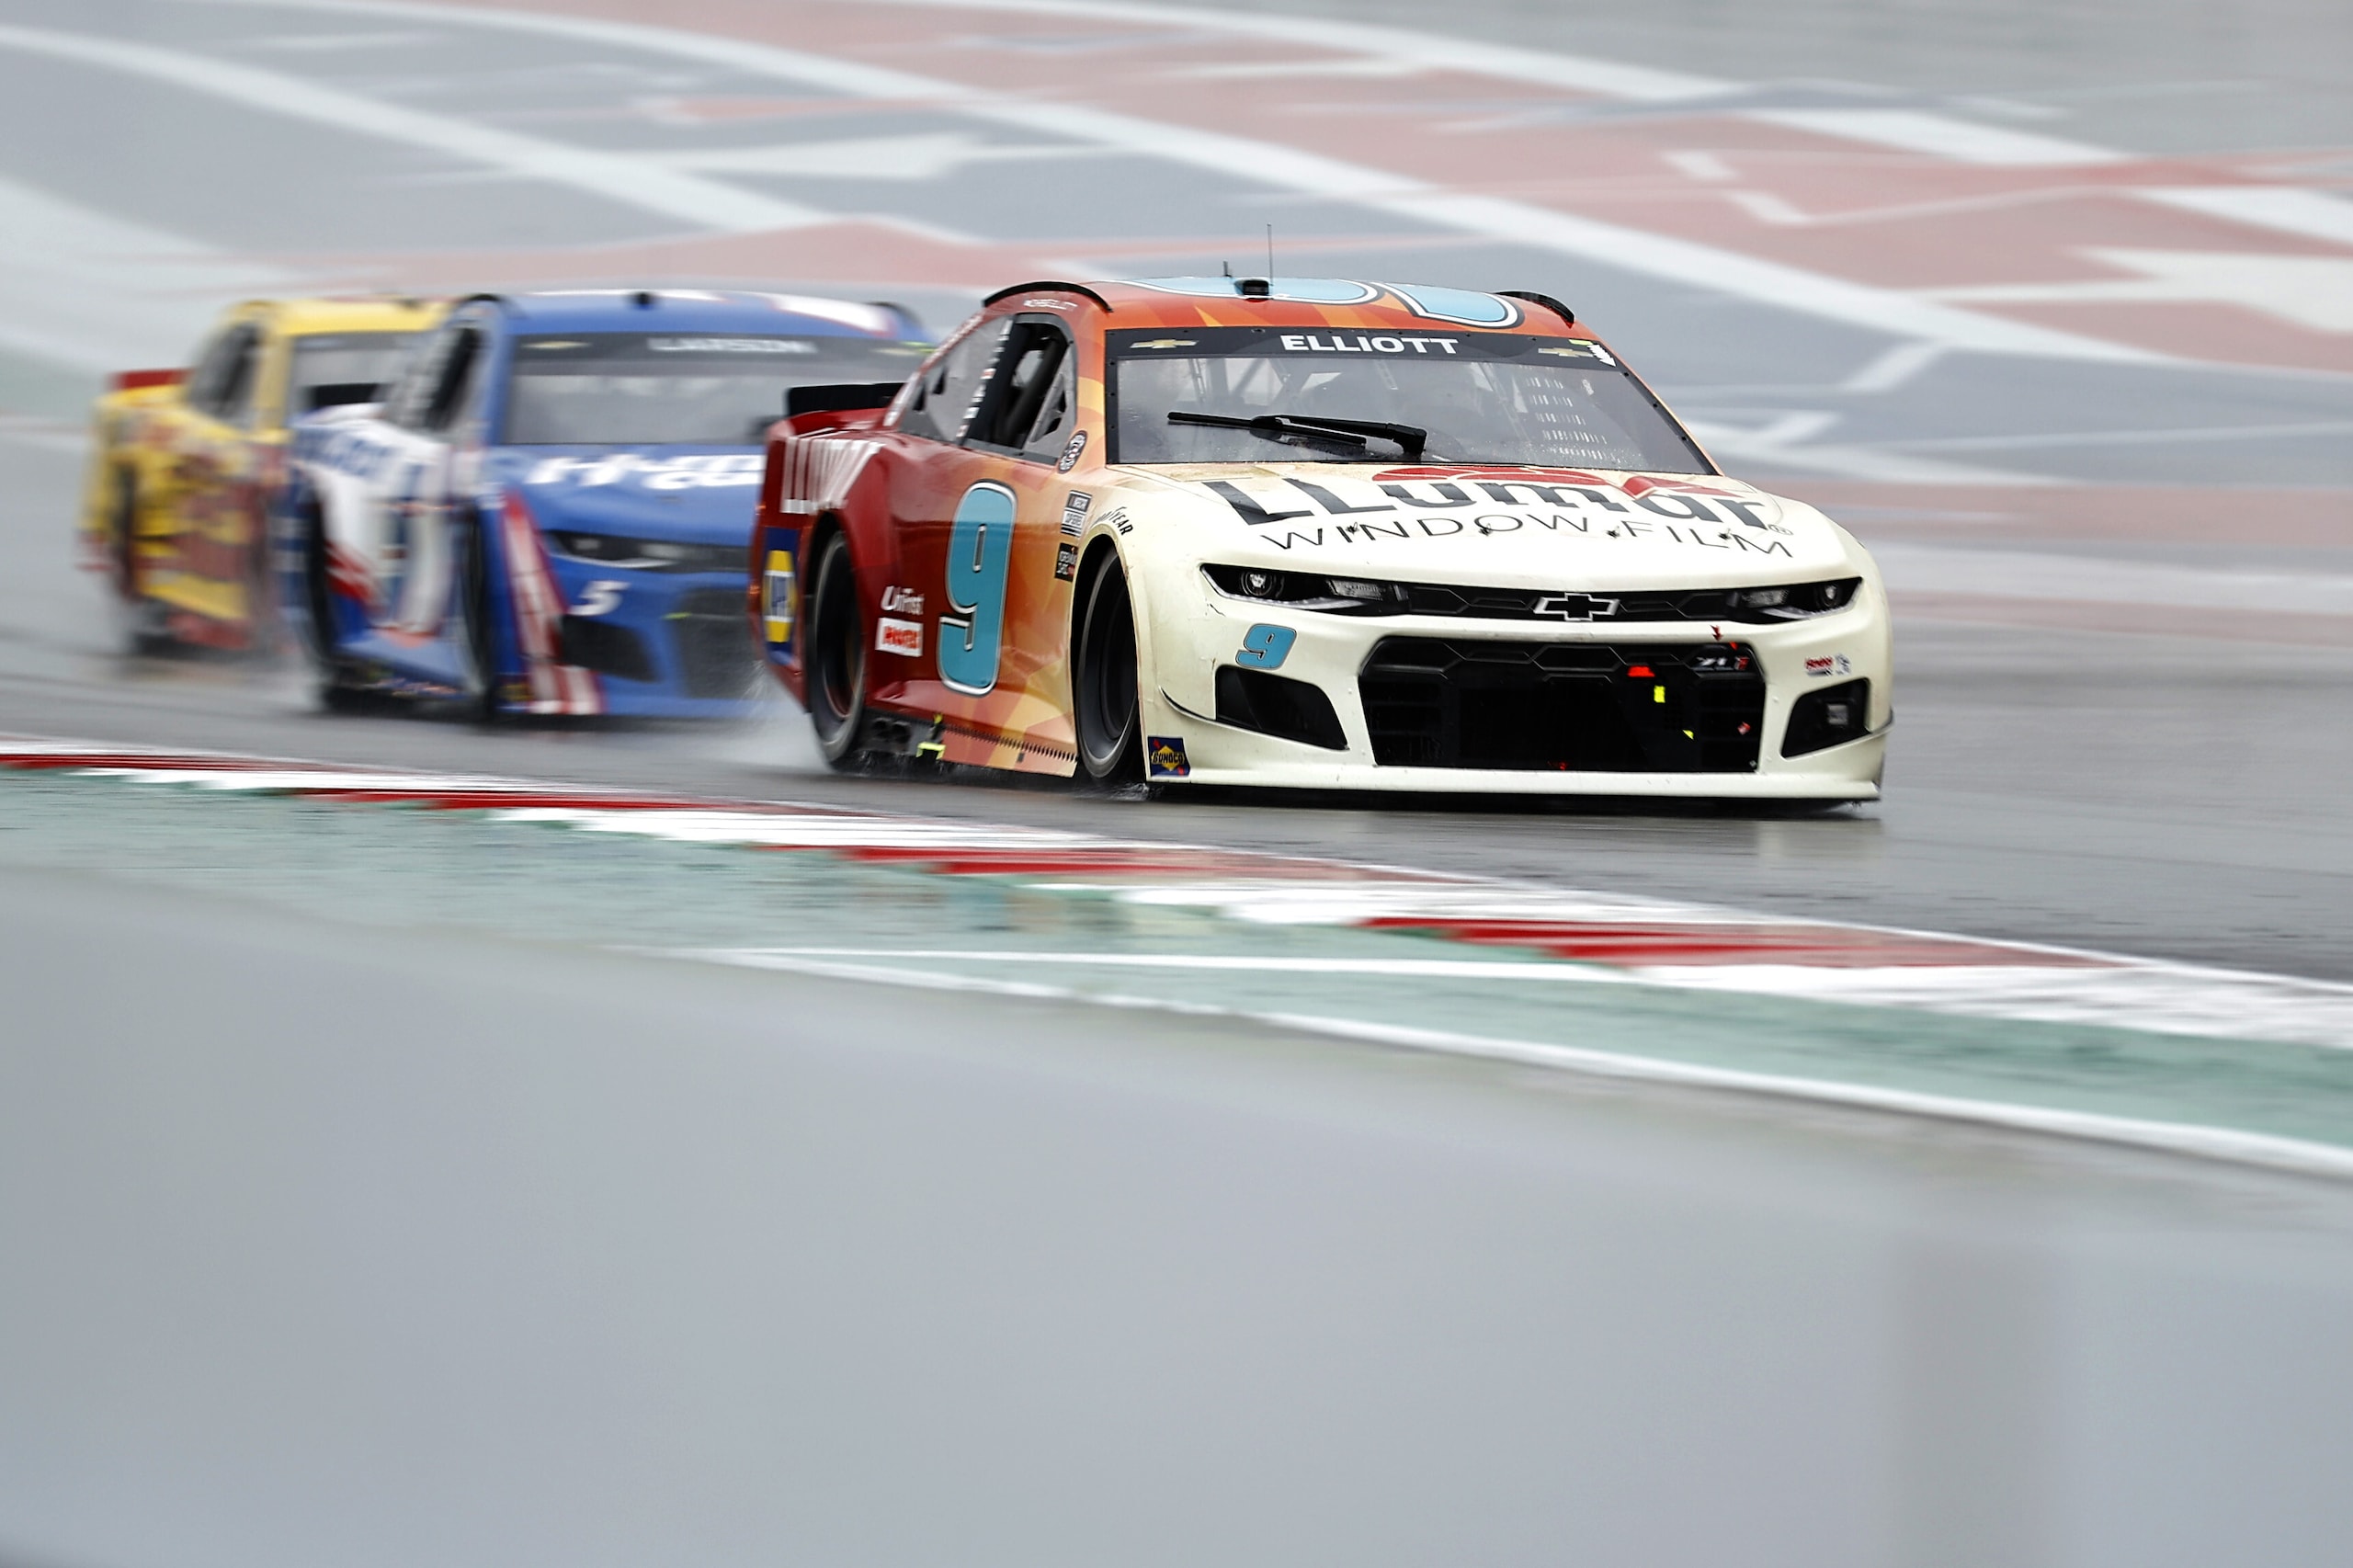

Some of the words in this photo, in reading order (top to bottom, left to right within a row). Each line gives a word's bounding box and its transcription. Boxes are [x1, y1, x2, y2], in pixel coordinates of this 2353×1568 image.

[1280, 335, 1459, 354] ELLIOTT
[1201, 478, 1768, 531] LLumar
[1260, 513, 1588, 550] WINDOW
[1623, 520, 1793, 558] FILM
[566, 579, 631, 617] 5
[937, 479, 1017, 698] 9
[1235, 622, 1297, 671] 9
